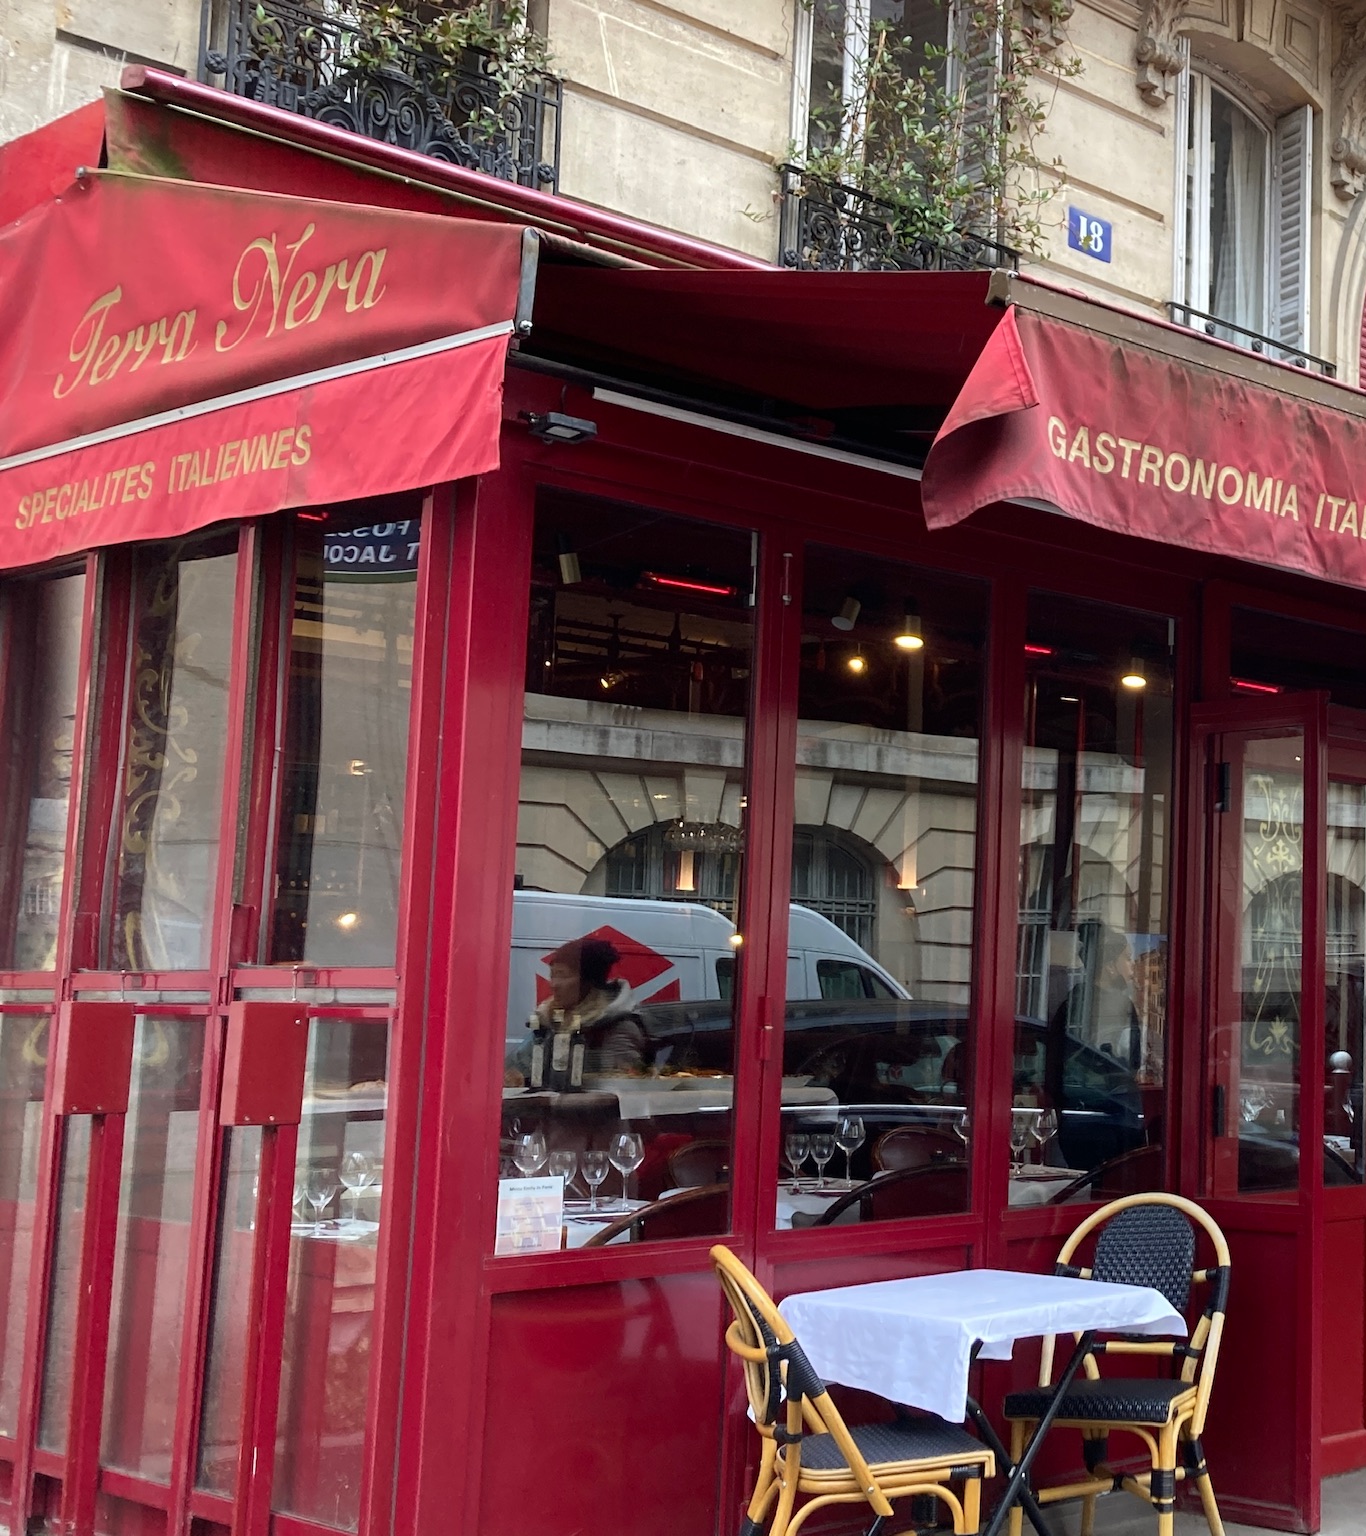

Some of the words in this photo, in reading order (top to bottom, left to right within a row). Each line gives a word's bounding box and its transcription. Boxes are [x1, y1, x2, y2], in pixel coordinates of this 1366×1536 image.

[1078, 215, 1104, 253] 18
[53, 285, 199, 399] Terra
[214, 223, 388, 353] Nera
[15, 461, 155, 530] SPECIALITES
[167, 424, 312, 495] ITALIENNES
[1047, 416, 1300, 522] GASTRONOMIA
